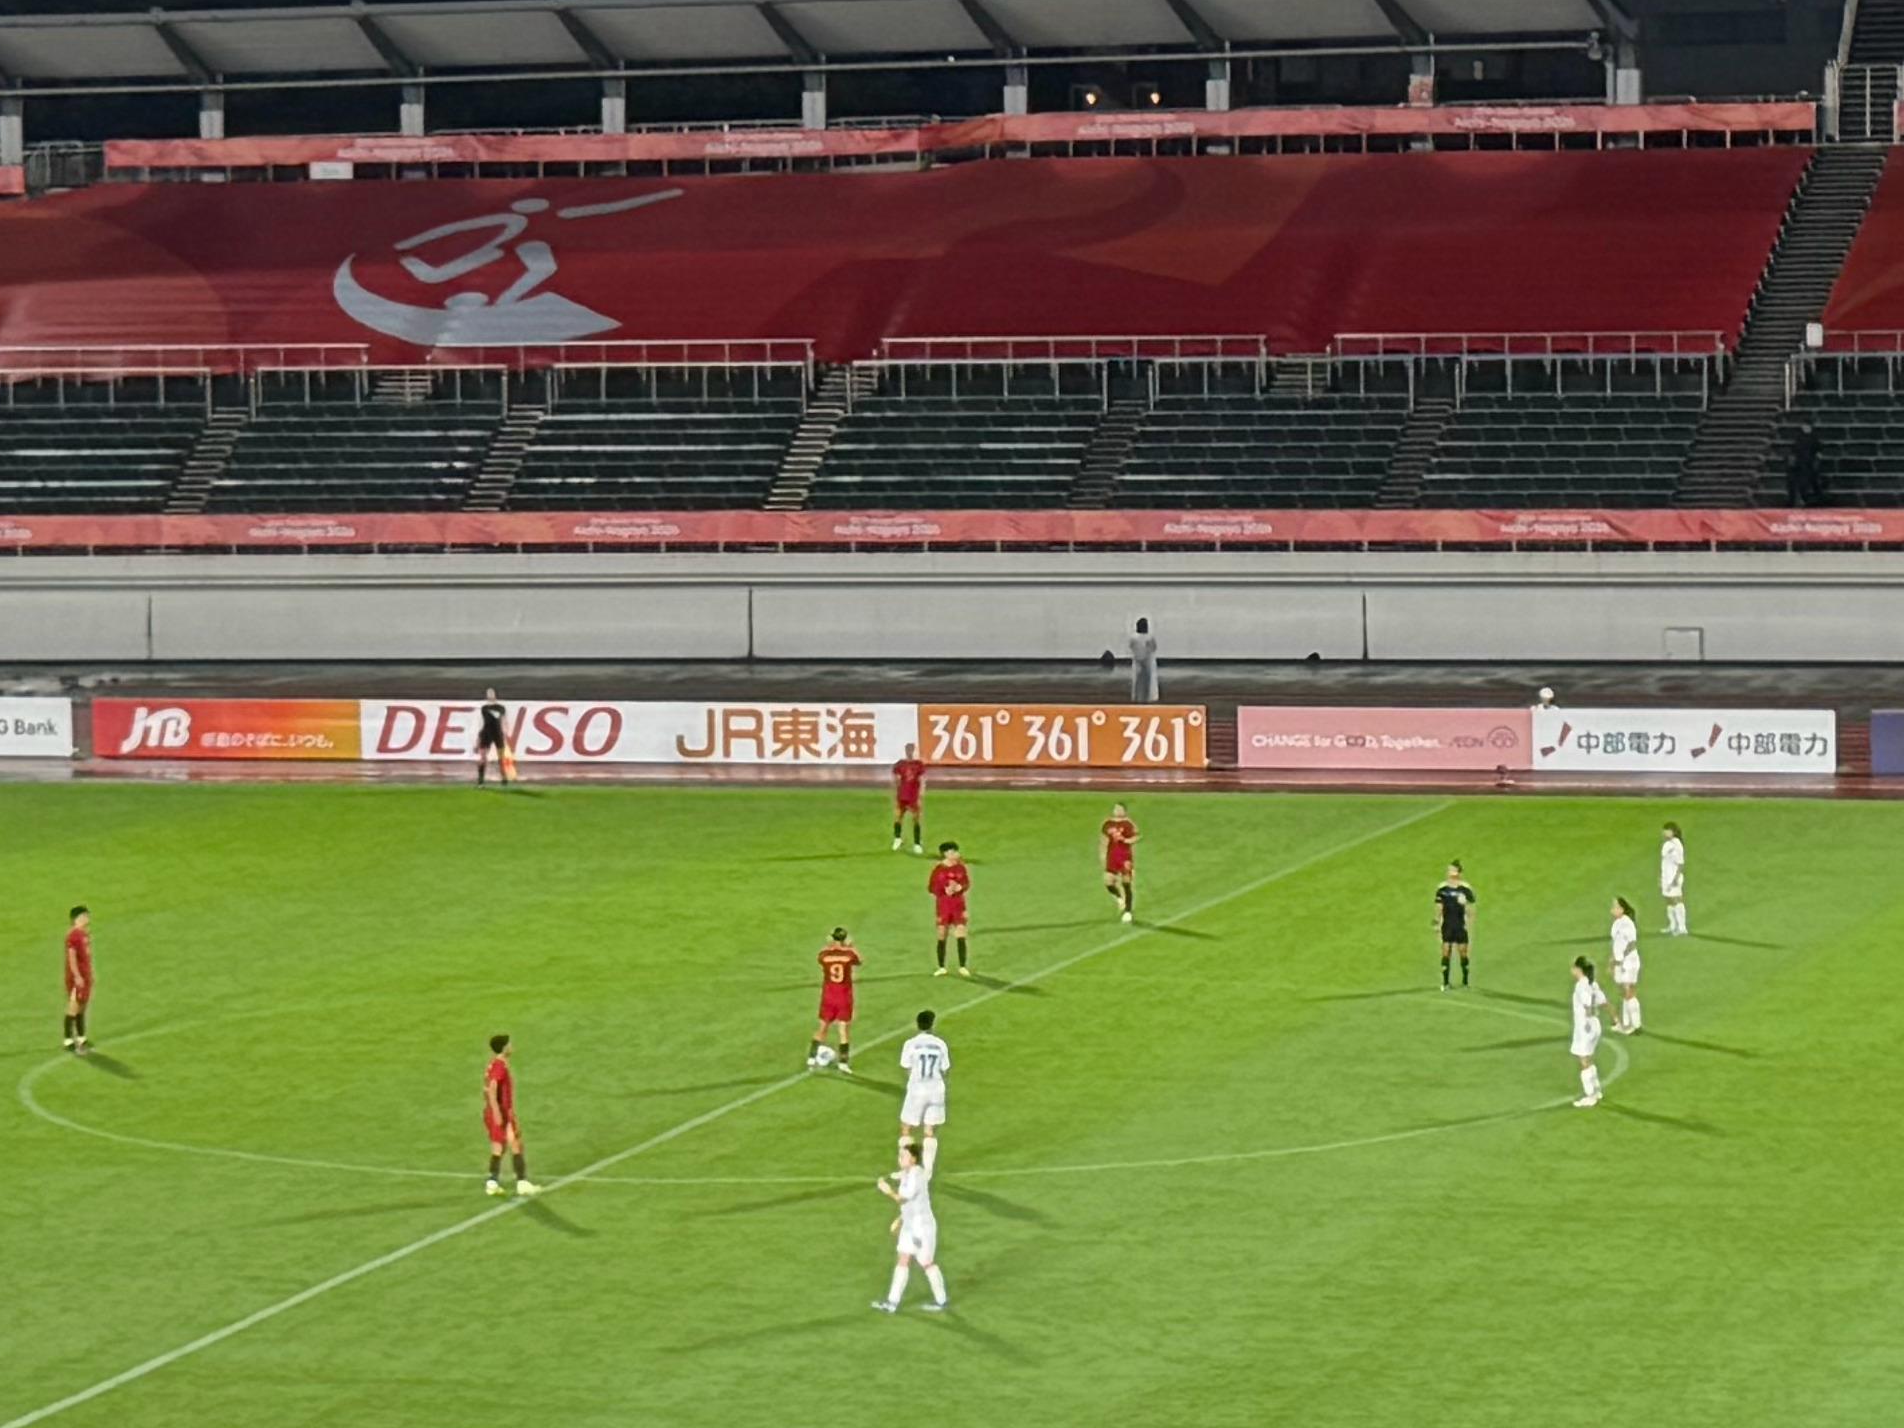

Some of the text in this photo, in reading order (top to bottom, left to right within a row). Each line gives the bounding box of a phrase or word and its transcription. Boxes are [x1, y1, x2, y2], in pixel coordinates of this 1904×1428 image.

[14, 718, 58, 736] Bank
[120, 706, 191, 754] JTB
[676, 708, 877, 759] JR東海
[1251, 734, 1312, 747] CHANGE
[1313, 734, 1332, 747] for
[1577, 730, 1676, 755] 中部電力
[1728, 732, 1828, 756] 中部電力
[830, 963, 844, 983] 9
[919, 1053, 939, 1079] 17
